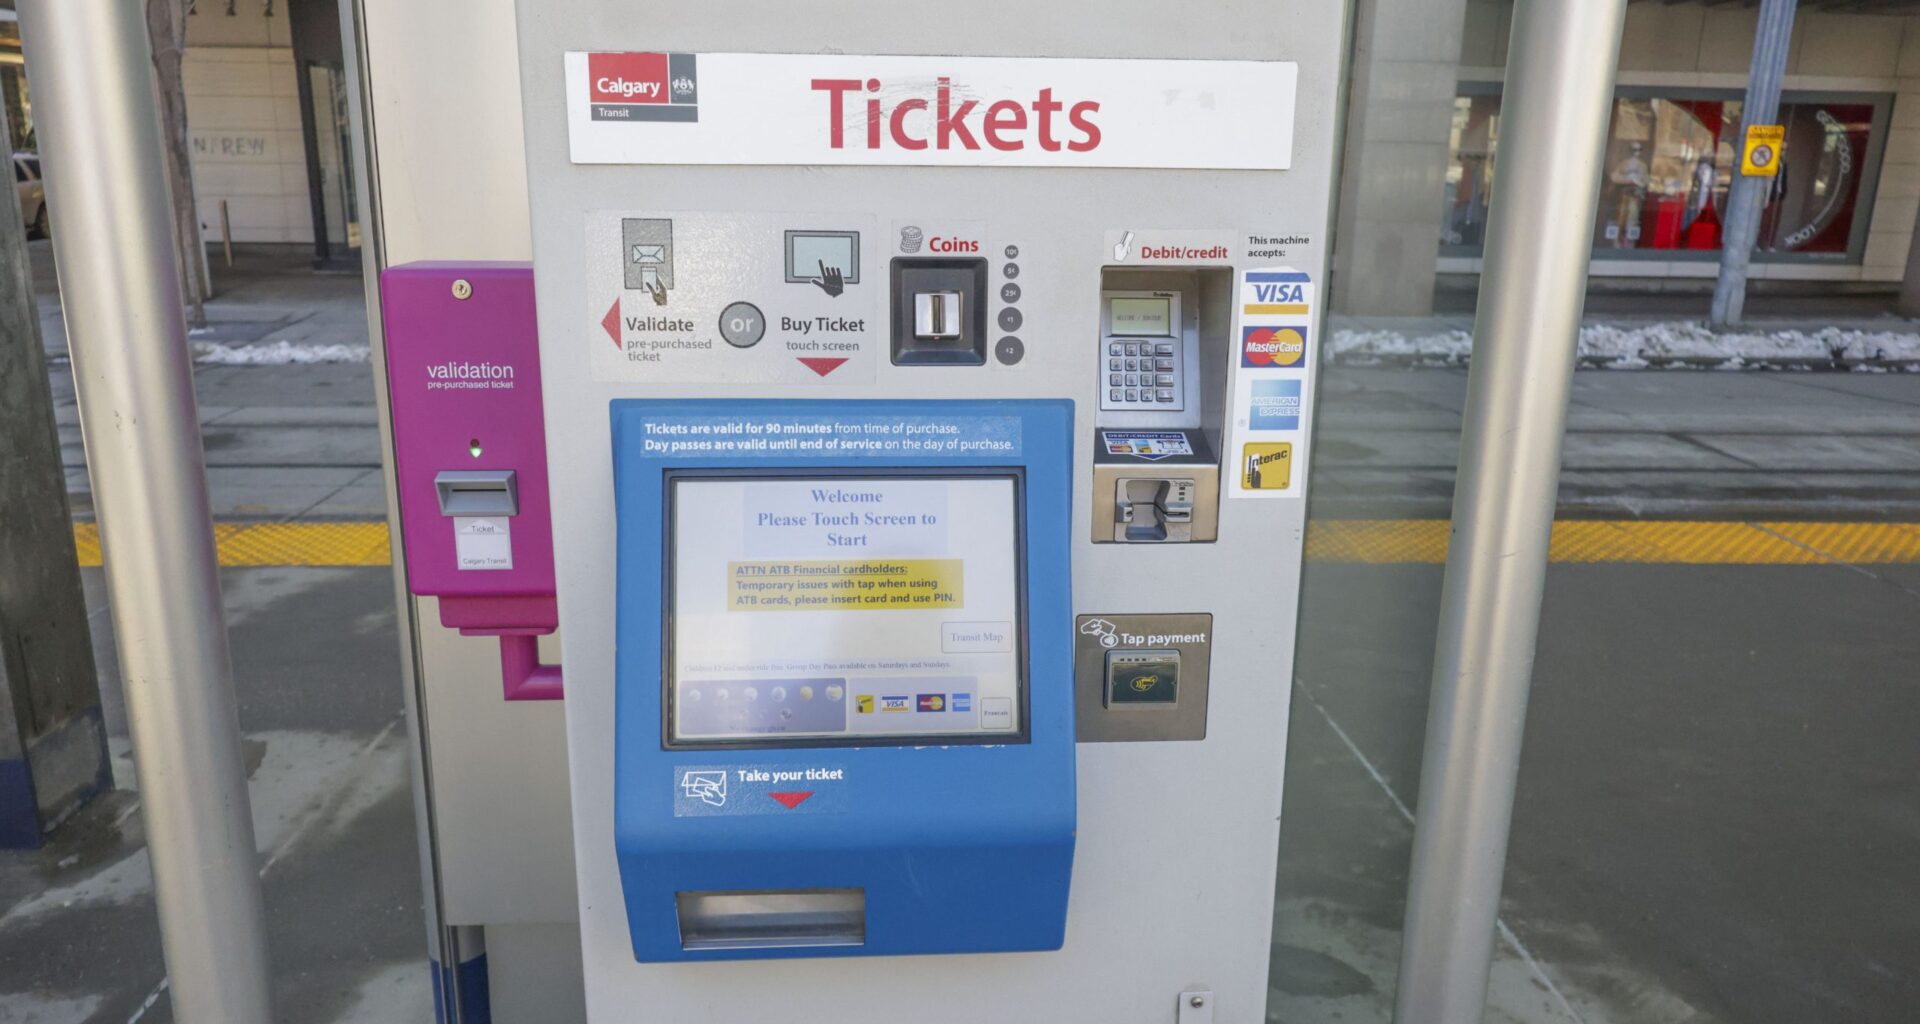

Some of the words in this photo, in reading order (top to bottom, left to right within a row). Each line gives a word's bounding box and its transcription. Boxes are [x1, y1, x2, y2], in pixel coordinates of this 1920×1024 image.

[597, 77, 660, 98] Calgary
[599, 107, 629, 118] Transit
[811, 77, 1102, 152] Tickets
[929, 236, 979, 253] Coins
[1249, 236, 1268, 246] This
[1270, 235, 1310, 246] machine
[1141, 246, 1228, 260] Debit/credit
[1248, 249, 1286, 258] accepts:
[1253, 284, 1304, 303] VISA
[626, 317, 695, 332] Validate
[730, 318, 754, 333] or
[781, 317, 812, 334] Buy
[816, 317, 865, 332] Ticket
[627, 338, 712, 350] pre-purchased
[786, 340, 820, 351] touch
[822, 341, 860, 351] screen
[1246, 342, 1304, 353] MasterCard
[628, 351, 661, 362] ticket
[427, 362, 514, 379] validation
[427, 381, 490, 390] pre-purchased
[491, 381, 514, 389] ticket
[1260, 407, 1301, 416] EXPRESS
[645, 423, 688, 434] Tickets
[690, 425, 713, 434] are
[714, 423, 743, 433] valid
[745, 423, 763, 433] for
[766, 424, 781, 433] 90
[783, 423, 832, 433] minutes
[834, 422, 862, 433] from
[864, 423, 889, 433] time
[892, 423, 904, 433] of
[906, 422, 961, 436] purchase.
[645, 439, 669, 452] Day
[671, 441, 712, 451] passes
[714, 441, 735, 450] are
[736, 439, 768, 450] valid
[769, 439, 798, 449] until
[800, 438, 823, 449] end
[825, 439, 838, 449] of
[840, 440, 882, 449] service
[884, 441, 900, 449] on
[902, 439, 921, 449] the
[923, 439, 944, 451] day
[946, 439, 958, 449] of
[960, 439, 1014, 451] purchase.
[1249, 450, 1288, 470] Interac
[811, 489, 884, 503] Welcome
[758, 512, 807, 526] Please
[812, 512, 859, 526] Touch
[864, 512, 916, 525] Screen
[921, 513, 937, 525] to
[827, 532, 868, 547] Start
[463, 558, 485, 566] Calgary
[736, 565, 767, 575] ATTN
[769, 565, 790, 574] ATB
[793, 564, 840, 574] Financial
[843, 564, 908, 574] cardholders:
[736, 581, 794, 592] Temporary
[797, 580, 829, 589] issues
[831, 579, 856, 589] with
[857, 579, 876, 590] tap
[878, 578, 908, 588] when
[910, 578, 938, 590] using
[736, 596, 758, 606] ATB
[760, 595, 792, 606] cards,
[795, 595, 829, 606] please
[831, 593, 863, 604] insert
[864, 593, 888, 603] card
[890, 592, 911, 602] and
[912, 594, 931, 603] use
[934, 592, 956, 602] PIN.
[951, 631, 982, 643] Transit
[984, 631, 1003, 644] Map
[1121, 633, 1144, 646] Tap
[1148, 633, 1206, 646] payment
[886, 700, 904, 708] VISA
[739, 770, 769, 782] Take
[772, 771, 801, 784] your
[805, 768, 843, 780] ticket
